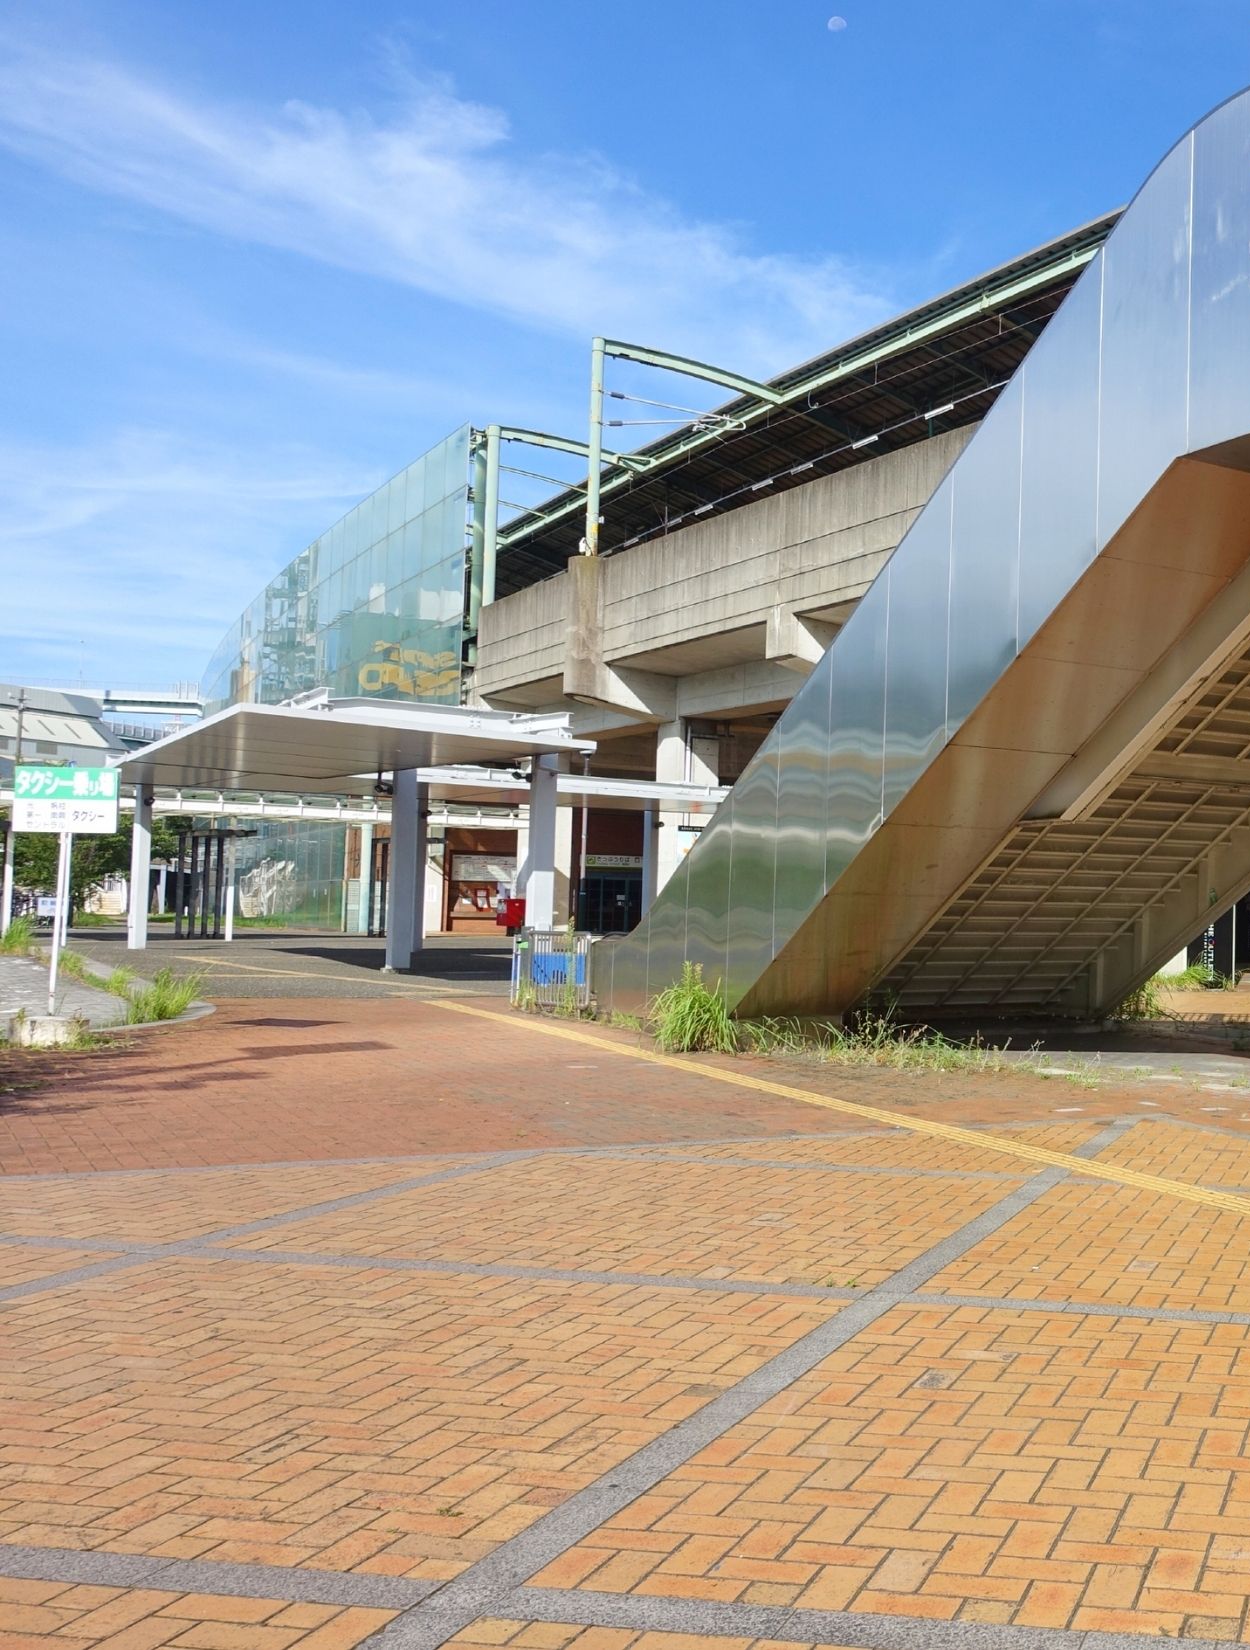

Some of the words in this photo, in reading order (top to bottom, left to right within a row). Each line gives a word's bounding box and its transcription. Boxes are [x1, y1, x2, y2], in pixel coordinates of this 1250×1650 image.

[16, 770, 115, 797] タクシー乗り場
[72, 810, 105, 822] タクシー
